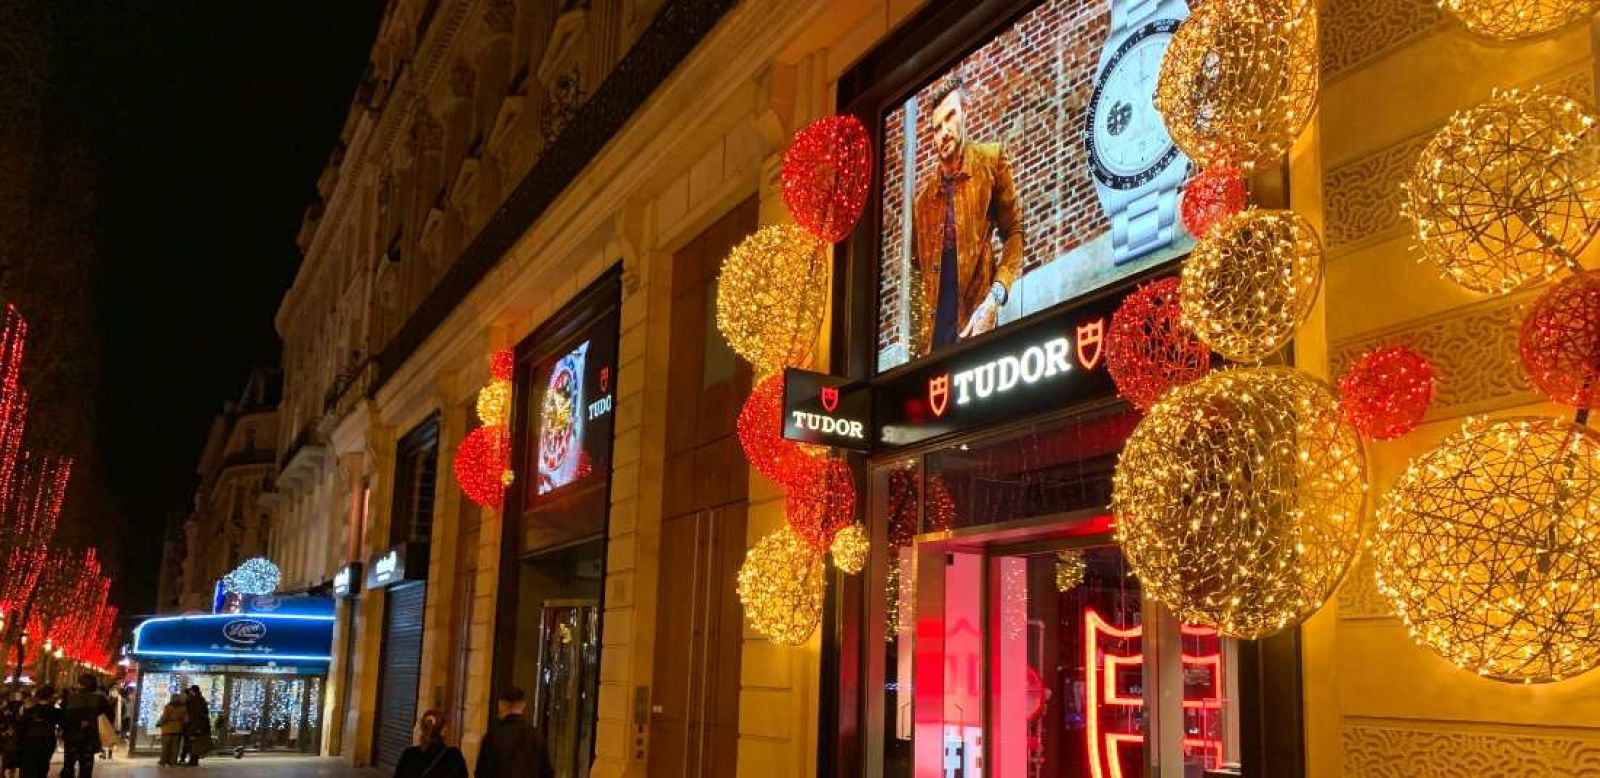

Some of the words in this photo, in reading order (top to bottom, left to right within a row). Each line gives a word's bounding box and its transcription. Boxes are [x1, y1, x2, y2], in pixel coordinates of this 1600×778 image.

[954, 338, 1071, 405] TUDOR
[589, 394, 611, 420] TUDO
[793, 411, 864, 438] TUDOR
